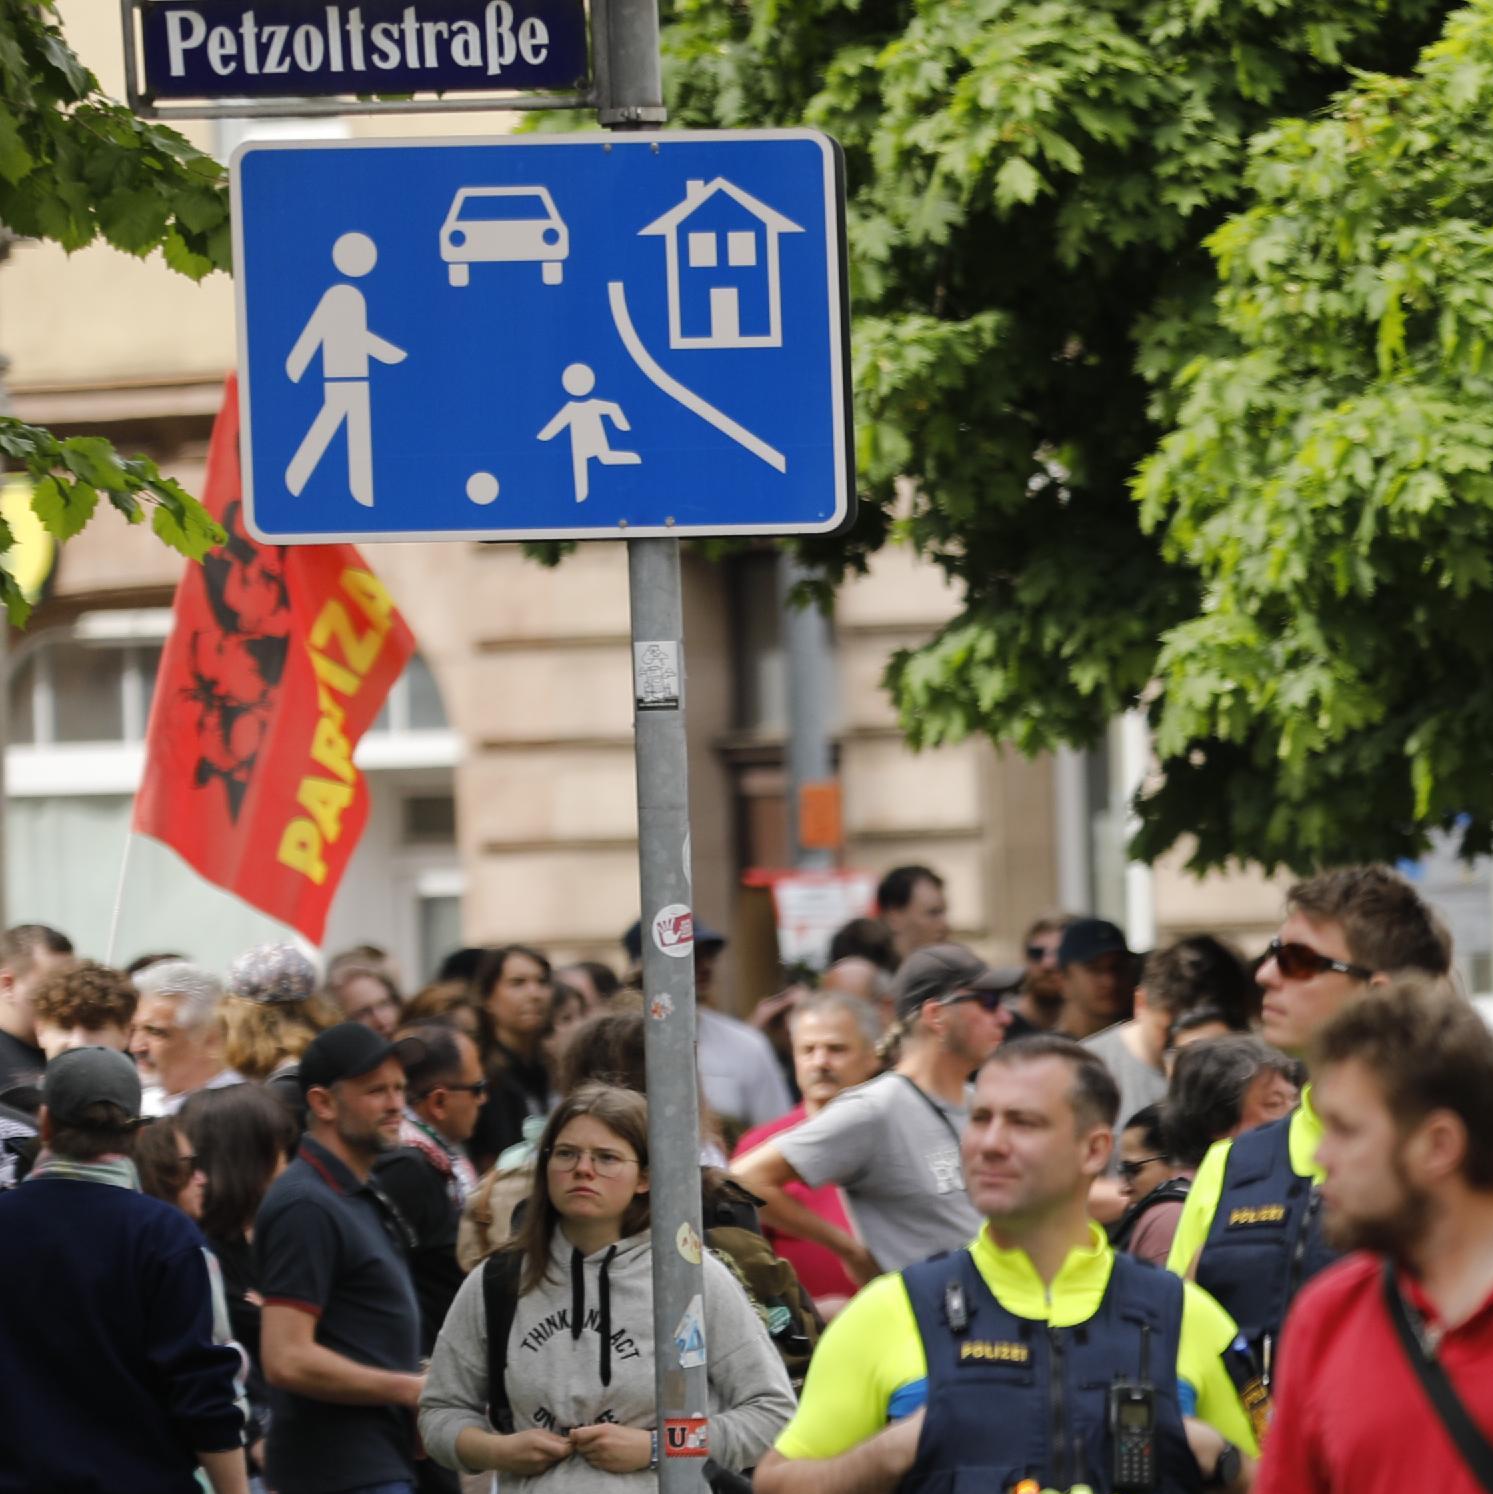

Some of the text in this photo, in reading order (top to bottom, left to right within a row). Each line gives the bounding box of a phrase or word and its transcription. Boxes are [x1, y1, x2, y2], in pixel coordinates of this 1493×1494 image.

[165, 0, 551, 77] Petzoltstraße
[1229, 1205, 1286, 1226] POLIZEI
[520, 1308, 572, 1352] THINK
[610, 1328, 641, 1360] ACT
[960, 1340, 1029, 1362] POLIZEI
